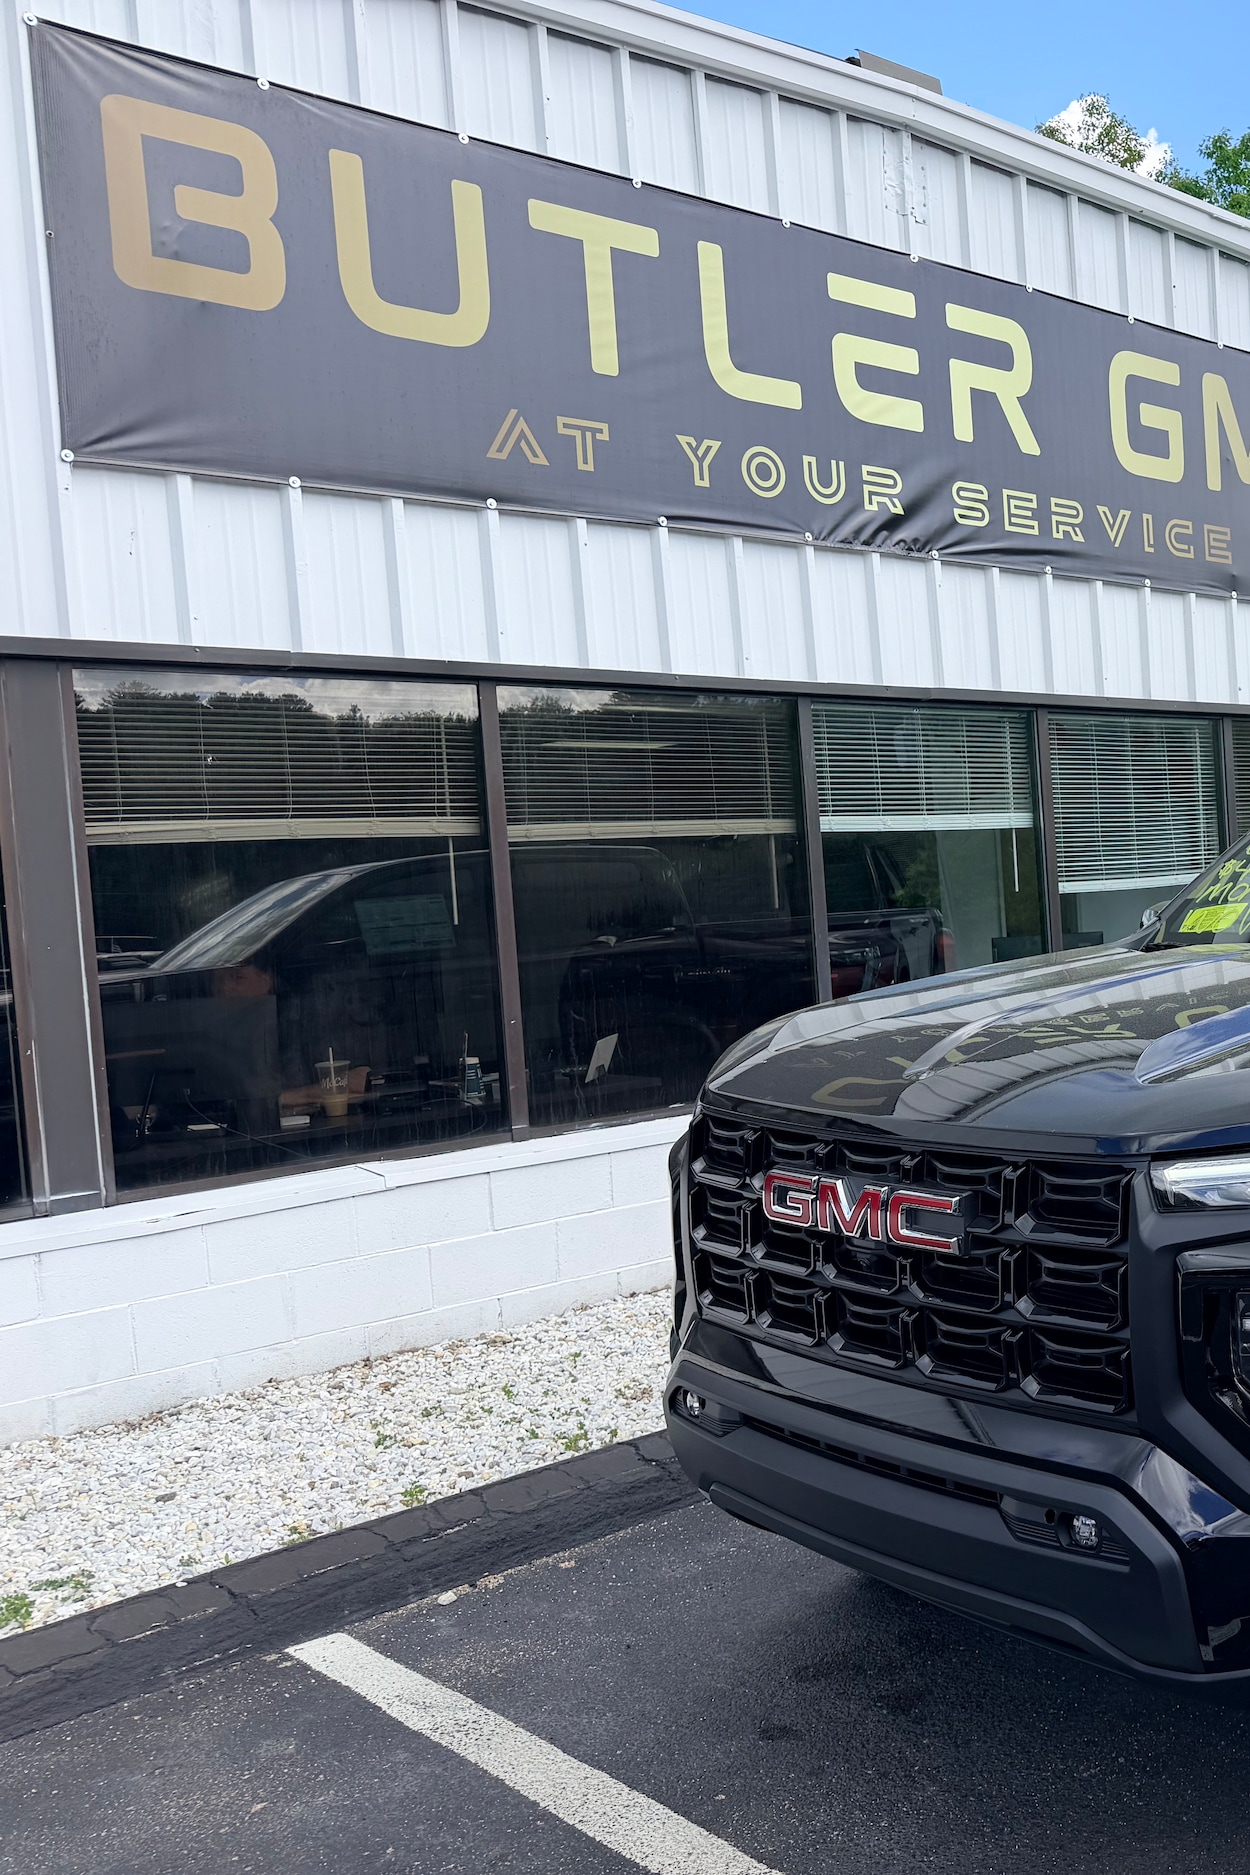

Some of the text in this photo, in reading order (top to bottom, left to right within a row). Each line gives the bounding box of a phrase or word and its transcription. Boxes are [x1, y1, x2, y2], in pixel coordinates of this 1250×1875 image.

[100, 94, 1040, 456] BUTLER
[486, 408, 1232, 565] AT YOUR SERVICE
[762, 1169, 962, 1255] GMC
